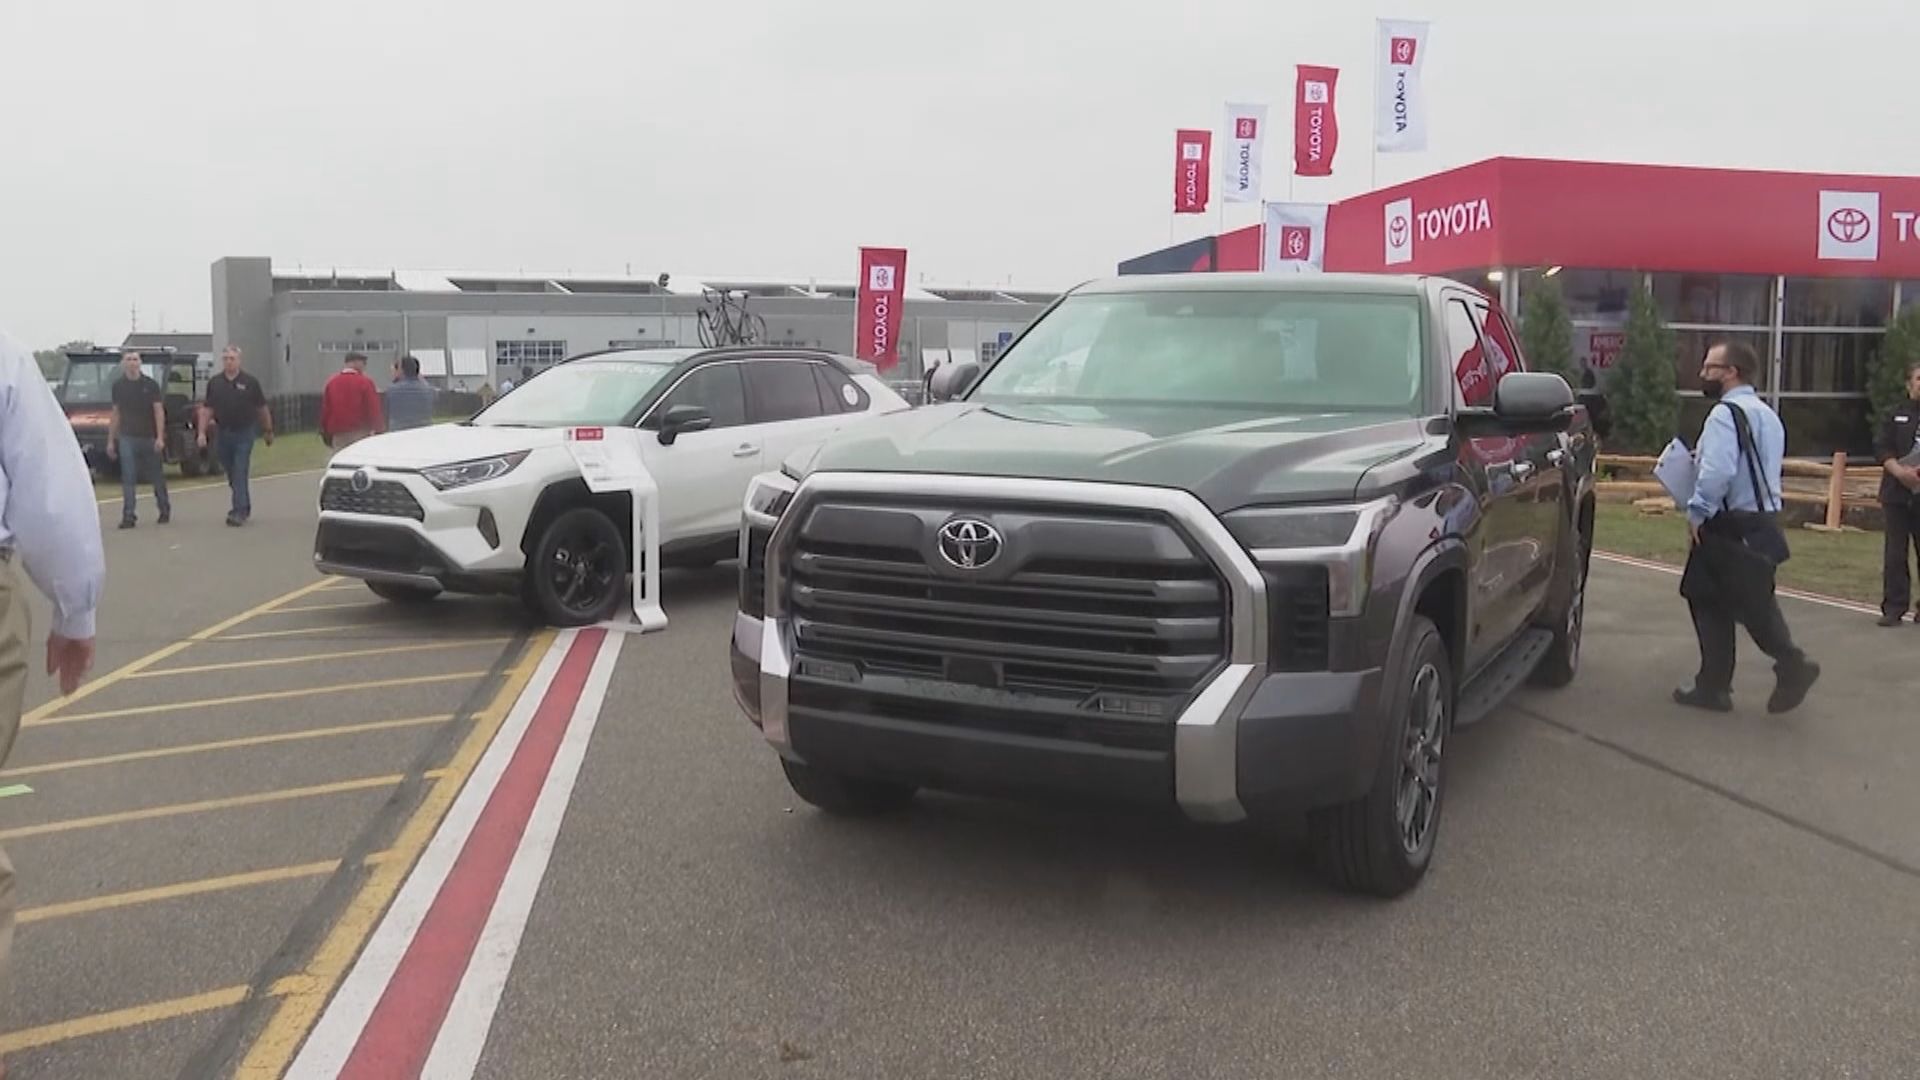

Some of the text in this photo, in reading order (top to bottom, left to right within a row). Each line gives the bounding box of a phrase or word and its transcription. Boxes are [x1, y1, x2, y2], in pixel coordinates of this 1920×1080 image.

[1393, 71, 1408, 133] TOYOTA
[1308, 107, 1323, 162] TOYOTA
[1185, 163, 1197, 206] TOYOTA
[1239, 144, 1251, 191] TOYOTA
[1417, 198, 1491, 241] TOYOTA
[1891, 211, 1920, 242] T
[874, 296, 888, 355] TOYOTA
